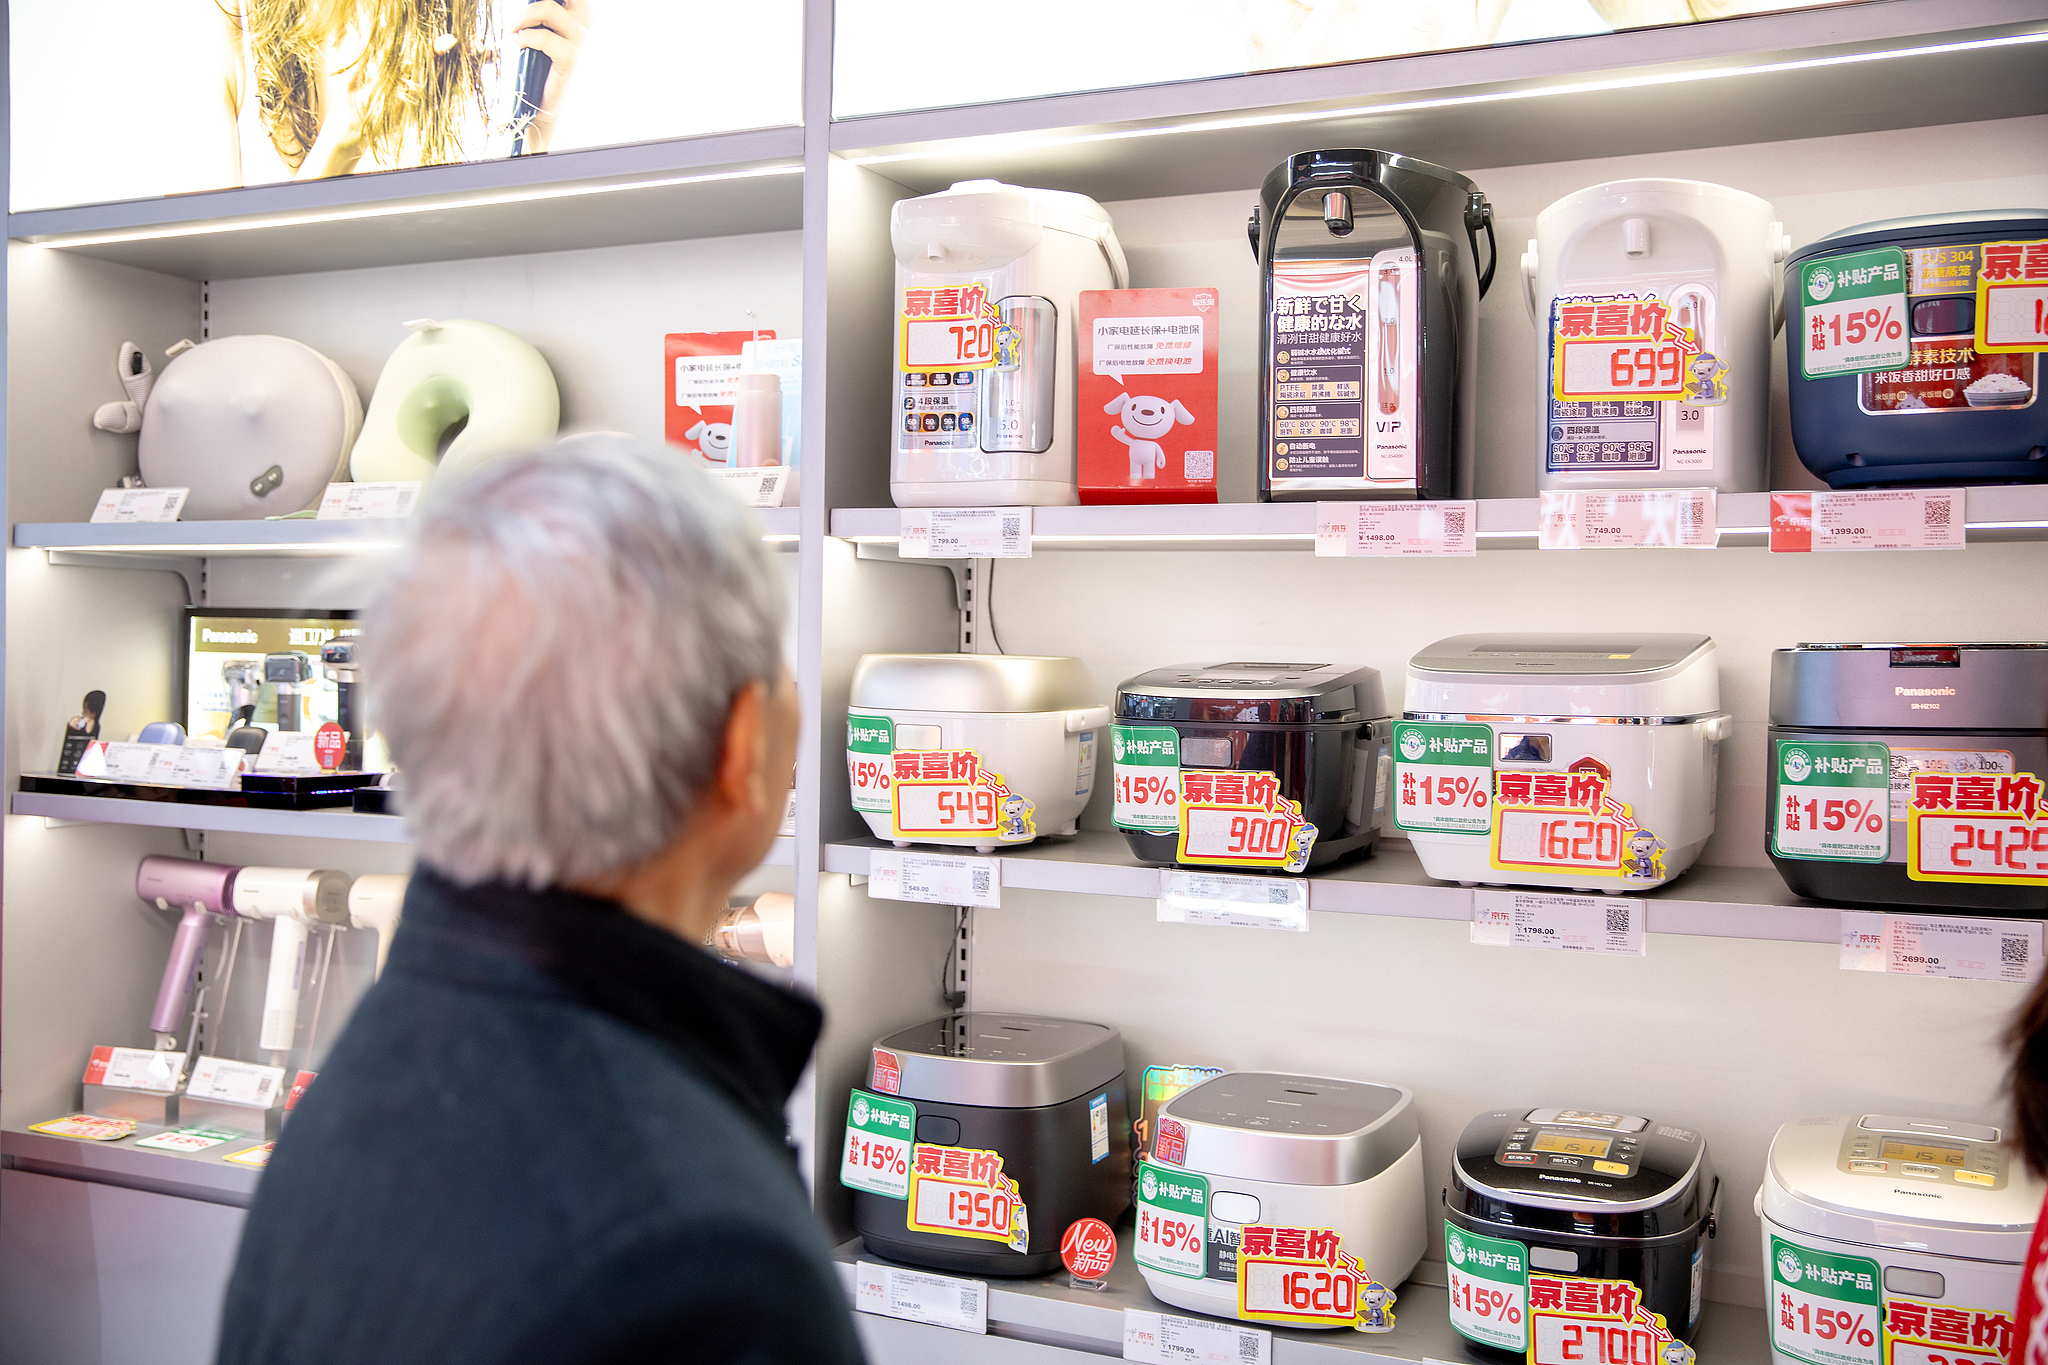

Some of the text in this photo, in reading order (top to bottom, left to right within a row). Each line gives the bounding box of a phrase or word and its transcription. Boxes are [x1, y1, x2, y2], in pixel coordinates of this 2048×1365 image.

[1922, 250, 1974, 265] SUS 304
[1837, 264, 1900, 287] 补贴产品
[903, 285, 984, 320] 京喜价
[1277, 295, 1361, 315] 新鲜で甘く
[1097, 325, 1200, 336] 小家电延长保+电池保
[1277, 314, 1362, 332] 健康的な水
[1559, 302, 1667, 343] 京喜价
[1828, 306, 1902, 347] 15%
[949, 323, 991, 360] 720
[1155, 341, 1192, 350] 免费维修
[1277, 332, 1362, 344] 清冽甘甜健康好水
[1146, 357, 1192, 365] 免费换电池
[1611, 347, 1680, 387] 699
[1875, 367, 1971, 384] 米饭香甜好口感
[918, 397, 949, 405] 4段保温
[1681, 410, 1699, 420] 3.0
[1376, 422, 1401, 433] VIP
[1567, 426, 1600, 435] 四段保温
[202, 628, 259, 644] Panasonic
[1895, 686, 1956, 697] Panasonic
[317, 731, 341, 749] 新品
[854, 728, 889, 743] 补贴产品
[1126, 740, 1175, 755] 补贴产品
[1429, 737, 1488, 755] 补贴产品
[852, 761, 890, 790] 15%
[893, 752, 978, 786] 京喜价
[1814, 756, 1884, 775] 补贴产品
[1122, 776, 1176, 805] 15%
[1183, 774, 1277, 814] 京喜价
[1420, 776, 1487, 808] 15%
[1499, 774, 1605, 817] 京喜价
[1913, 776, 2039, 822] 京喜价
[938, 791, 993, 824] 549
[1804, 799, 1883, 833] 15%
[1228, 816, 1287, 853] 900
[1540, 820, 1616, 862] 1620
[870, 1108, 910, 1130] 补贴产品
[861, 1141, 906, 1175] 15%
[1157, 1137, 1184, 1164] 新品
[915, 1147, 1001, 1190] 京喜价
[1539, 1173, 1582, 1183] Panasonic
[1158, 1181, 1204, 1204] 补贴产品
[1894, 1189, 1942, 1199] Panasonic
[949, 1192, 1008, 1230] 1350
[1061, 1223, 1112, 1253] New
[1151, 1216, 1201, 1254] 15%
[1242, 1226, 1341, 1269] 京喜价
[1071, 1251, 1111, 1273] 新品
[1467, 1246, 1521, 1272] 补贴产品
[1805, 1263, 1873, 1291] 补贴产品
[1283, 1271, 1352, 1313] 1620
[1462, 1282, 1521, 1325] 15%
[1529, 1279, 1638, 1324] 京喜价
[1797, 1303, 1875, 1348] 15%
[1887, 1302, 2014, 1357] 京喜价
[1562, 1324, 1651, 1365] 2700
